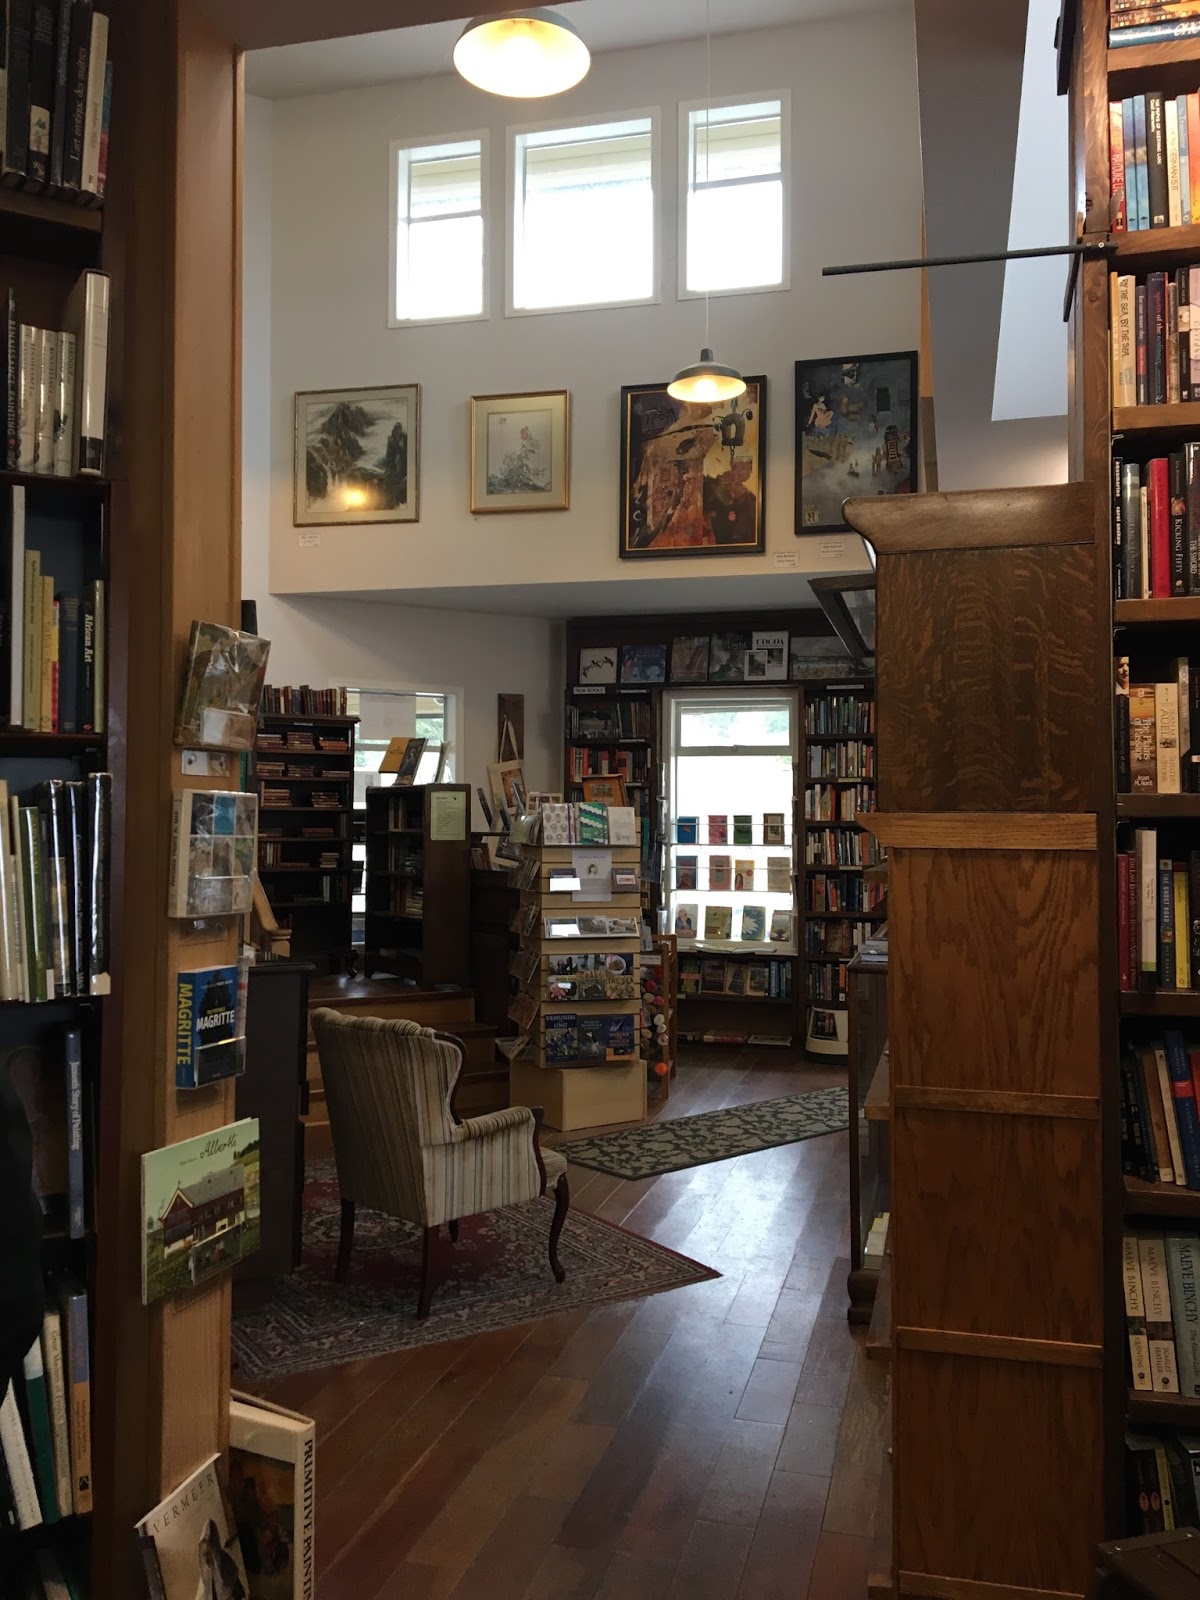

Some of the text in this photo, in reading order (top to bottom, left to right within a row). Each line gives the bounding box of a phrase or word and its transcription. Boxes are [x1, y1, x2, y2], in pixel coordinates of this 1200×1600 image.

[1120, 279, 1129, 287] BY
[1120, 289, 1129, 301] THE
[1120, 318, 1129, 328] BY
[1121, 329, 1130, 342] THE
[1156, 323, 1164, 335] the
[1175, 519, 1183, 574] KICKING FIFTY
[1190, 552, 1198, 575] SWORD
[84, 614, 93, 646] African
[84, 648, 93, 663] Art
[728, 640, 748, 651] Light
[1160, 709, 1169, 738] AUEL
[1132, 718, 1143, 761] of Passage
[1141, 718, 1153, 760] The Plains
[177, 983, 193, 1065] MAGRITTE
[196, 1010, 235, 1031] MAGRITTE
[70, 1090, 80, 1110] Story
[71, 1119, 81, 1150] Painting
[1124, 1242, 1139, 1312] MAEVE BINCHY
[1179, 1245, 1192, 1280] MAEVE
[1147, 1247, 1163, 1317] MAEVE BINCHY
[1183, 1282, 1199, 1325] BINCHY
[1163, 1347, 1172, 1373] SCARLET
[303, 1439, 313, 1535] PRIMITIVE
[152, 1473, 216, 1535] VERMEER
